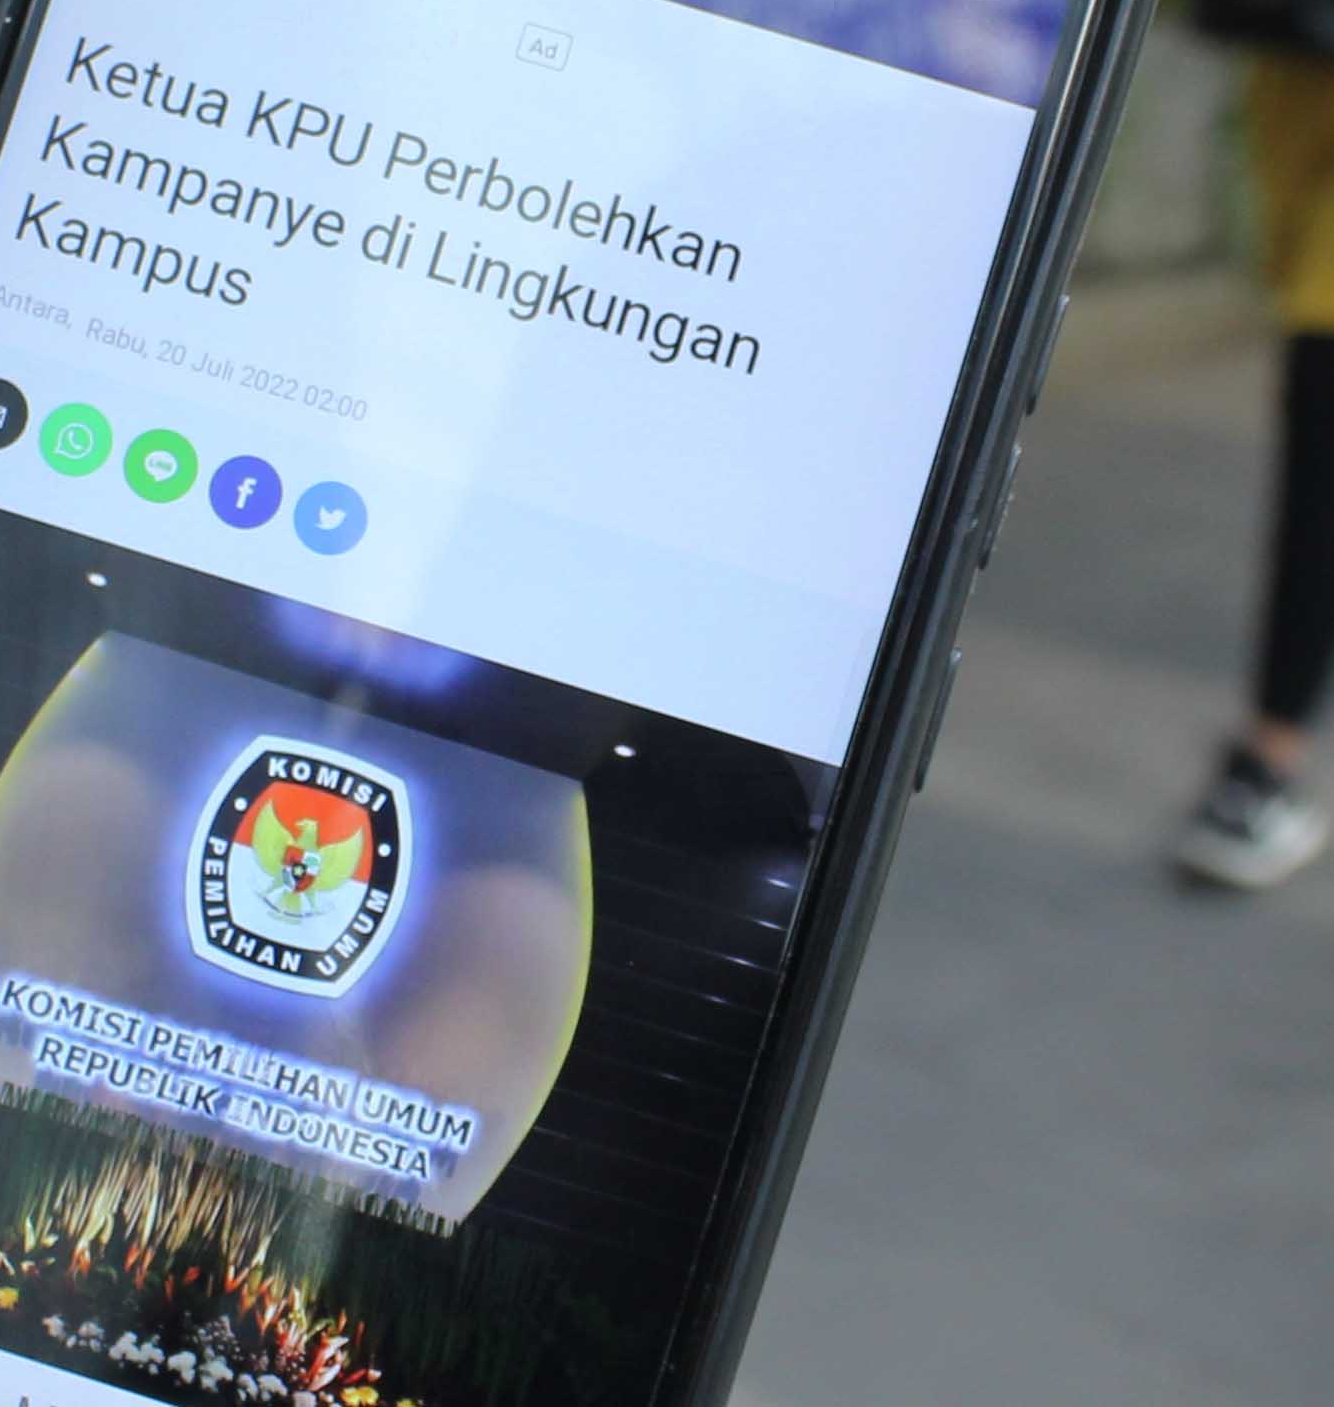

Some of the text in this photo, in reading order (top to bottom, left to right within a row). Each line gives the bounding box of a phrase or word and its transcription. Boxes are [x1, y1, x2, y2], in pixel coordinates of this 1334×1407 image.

[529, 38, 559, 59] Ad
[66, 37, 741, 282] Ketua KPU Perbolehkan
[16, 193, 251, 305] Kampus
[41, 115, 759, 375] Kampanye di Lingkungan
[85, 318, 148, 359] Rabu,
[156, 340, 187, 366] 20
[191, 352, 235, 382] Juli
[239, 365, 302, 401] 2022
[303, 384, 369, 422] 02:00
[268, 756, 386, 813] KOMISI
[205, 835, 389, 976] PEMILIHAN UMUM
[2, 978, 472, 1146] KOMISI PEMILIHAN UMUM
[38, 1036, 432, 1180] REPUBLIK INDONESIA
